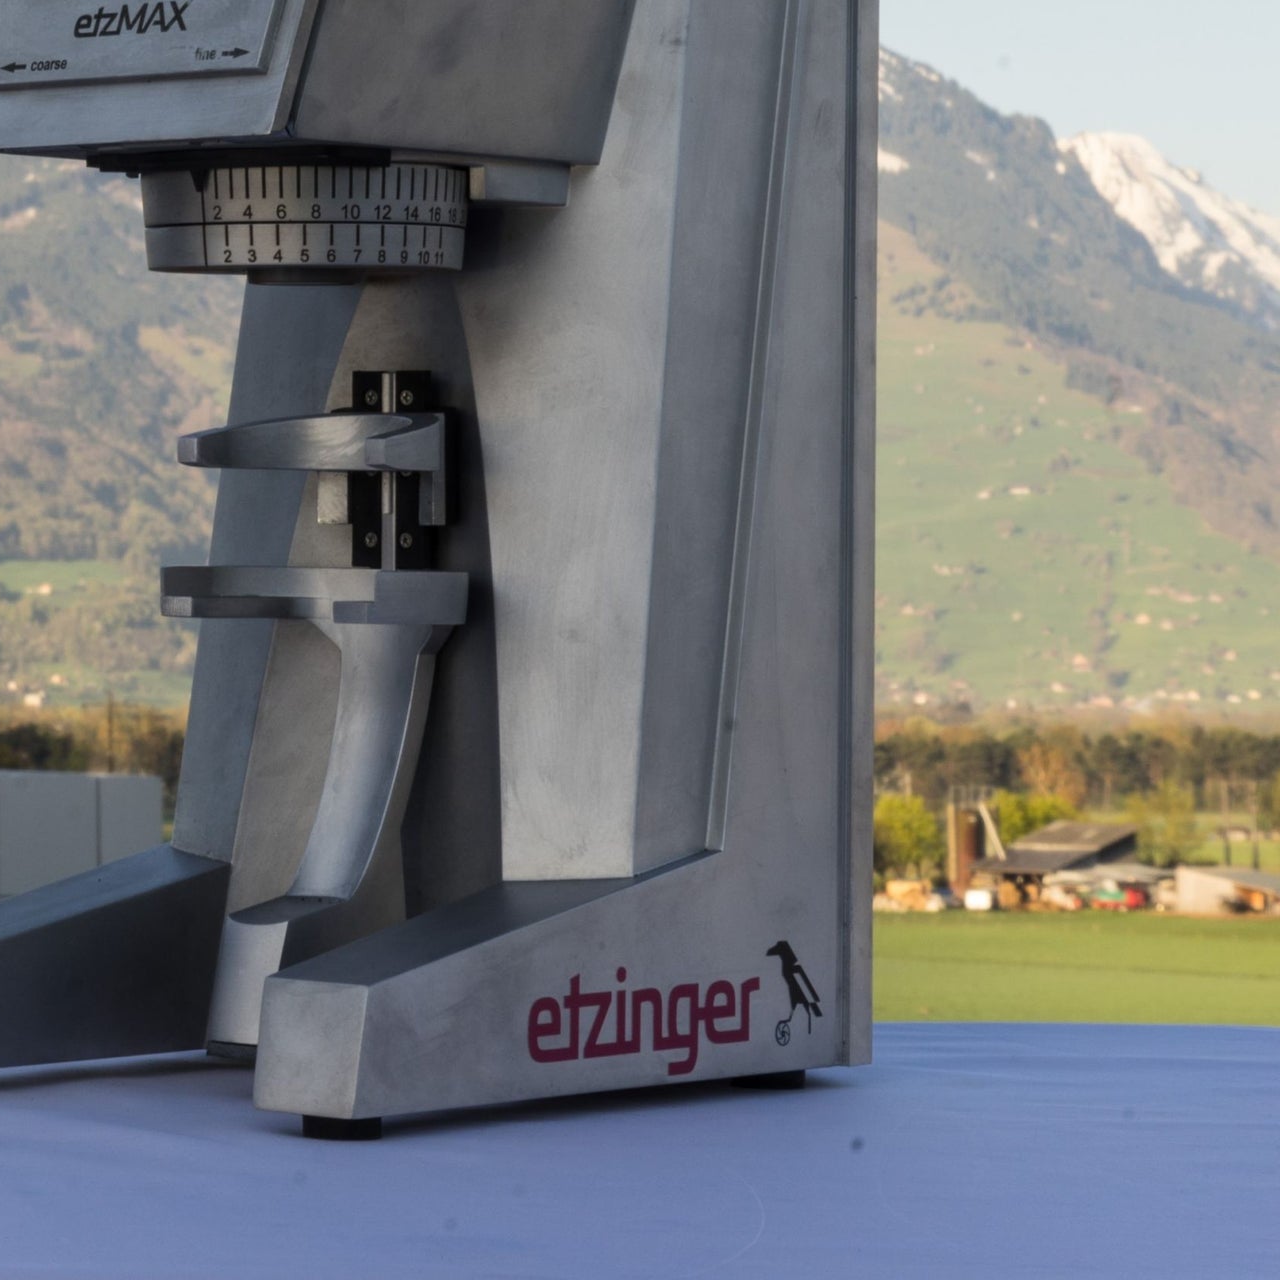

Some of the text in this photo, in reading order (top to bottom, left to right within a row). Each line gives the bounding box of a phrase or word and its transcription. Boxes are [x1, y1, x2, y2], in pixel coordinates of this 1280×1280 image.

[73, 0, 193, 38] etzMAX
[195, 47, 217, 61] fine
[30, 58, 68, 71] coarse
[212, 205, 222, 220] 2
[242, 204, 253, 219] 4
[276, 204, 287, 219] 6
[311, 204, 321, 219] 8
[341, 204, 361, 220] 10
[374, 204, 392, 220] 12
[403, 205, 419, 221] 14
[429, 206, 442, 222] 16
[448, 207, 457, 223] 18
[223, 249, 444, 264] 2 3 4 5 6 7 8 9 10 11
[527, 966, 760, 1076] etzinger
